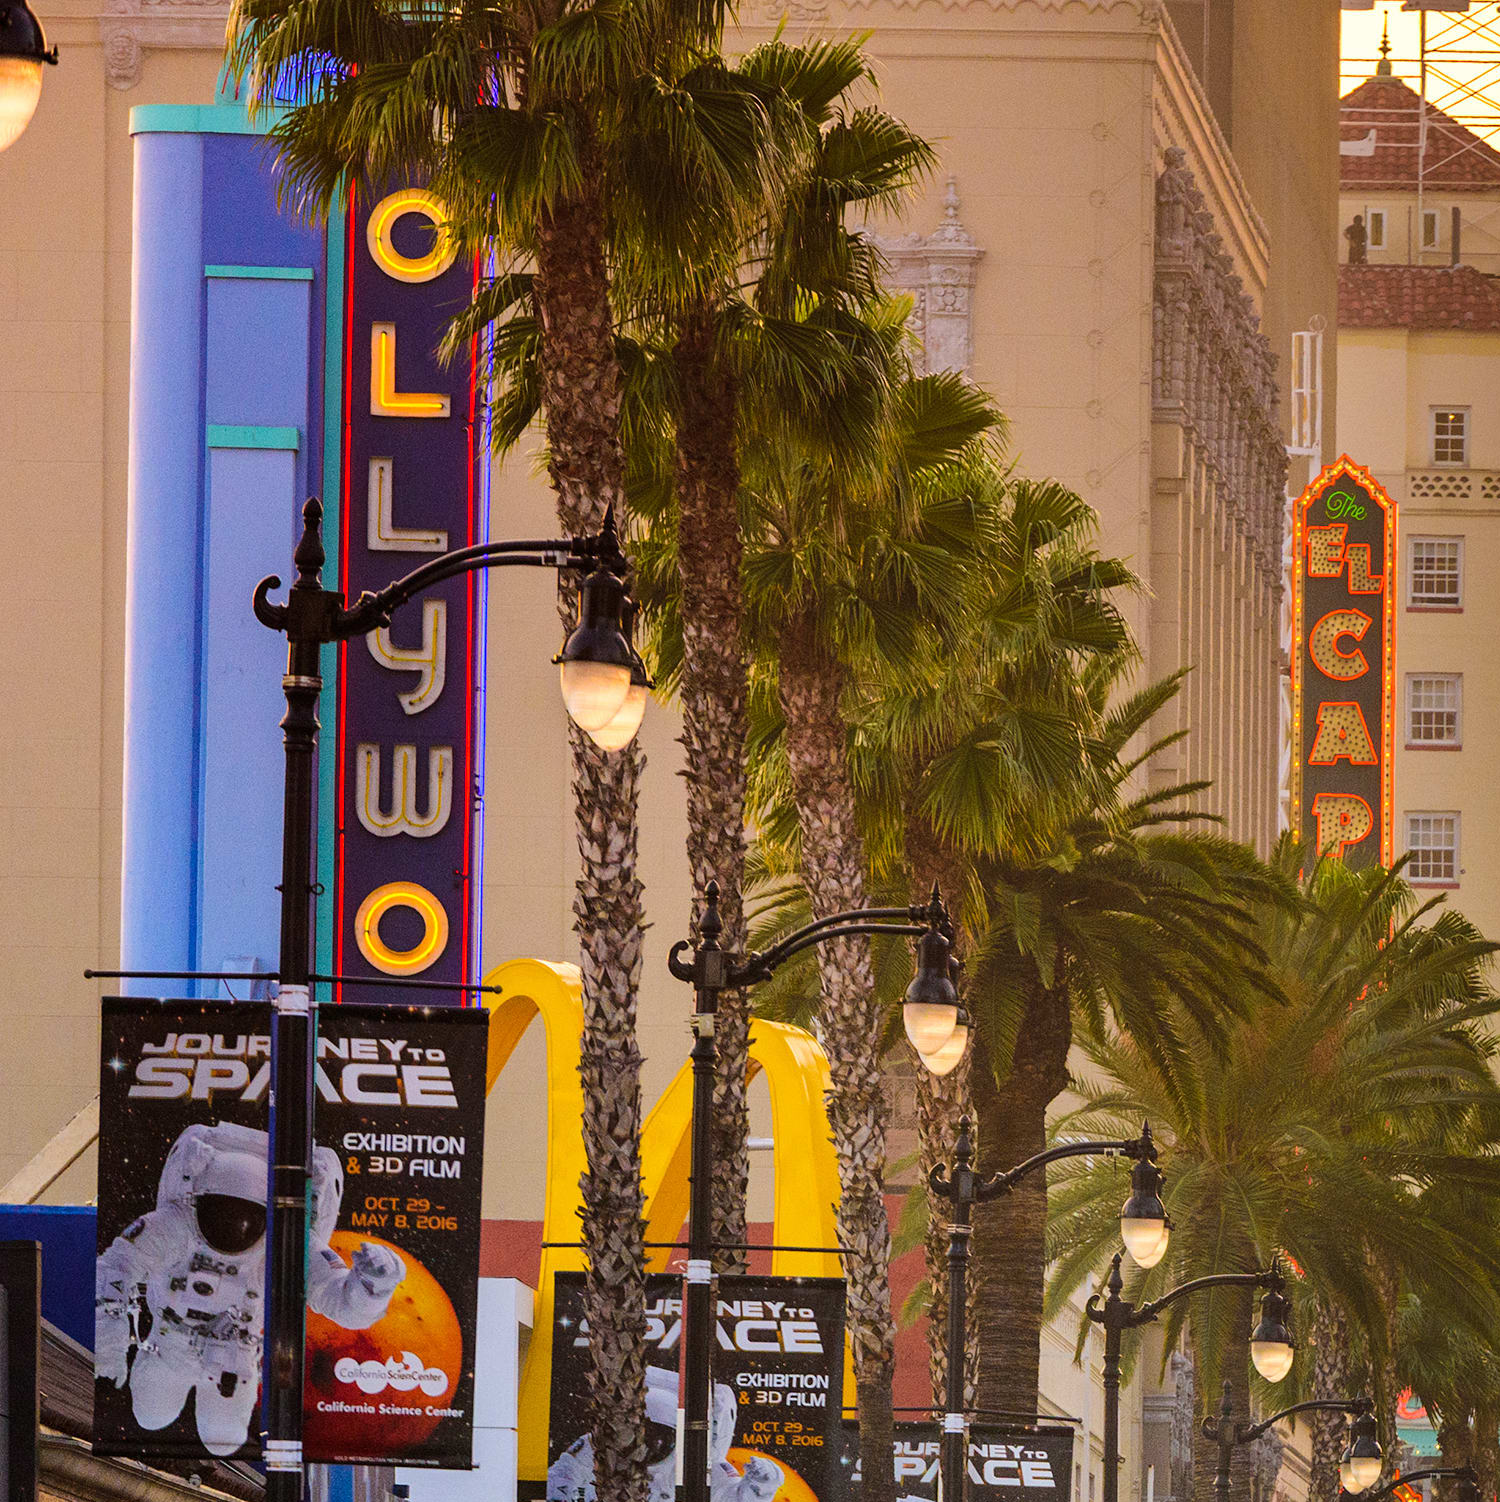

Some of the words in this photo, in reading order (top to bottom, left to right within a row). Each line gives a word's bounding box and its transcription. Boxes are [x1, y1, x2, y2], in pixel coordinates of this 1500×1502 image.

[1325, 491, 1367, 521] The
[1306, 523, 1384, 595] EL
[1308, 608, 1379, 858] CAP
[343, 1132, 466, 1156] EXHIBITION
[346, 1156, 361, 1174] &
[369, 1157, 404, 1174] 3D
[409, 1160, 461, 1179] FILM
[352, 1212, 385, 1228] MAY
[736, 1373, 829, 1389] EXHIBITION
[317, 1401, 375, 1414] California
[379, 1403, 422, 1416] Science
[425, 1405, 465, 1418] Center
[786, 1393, 826, 1408] FILM
